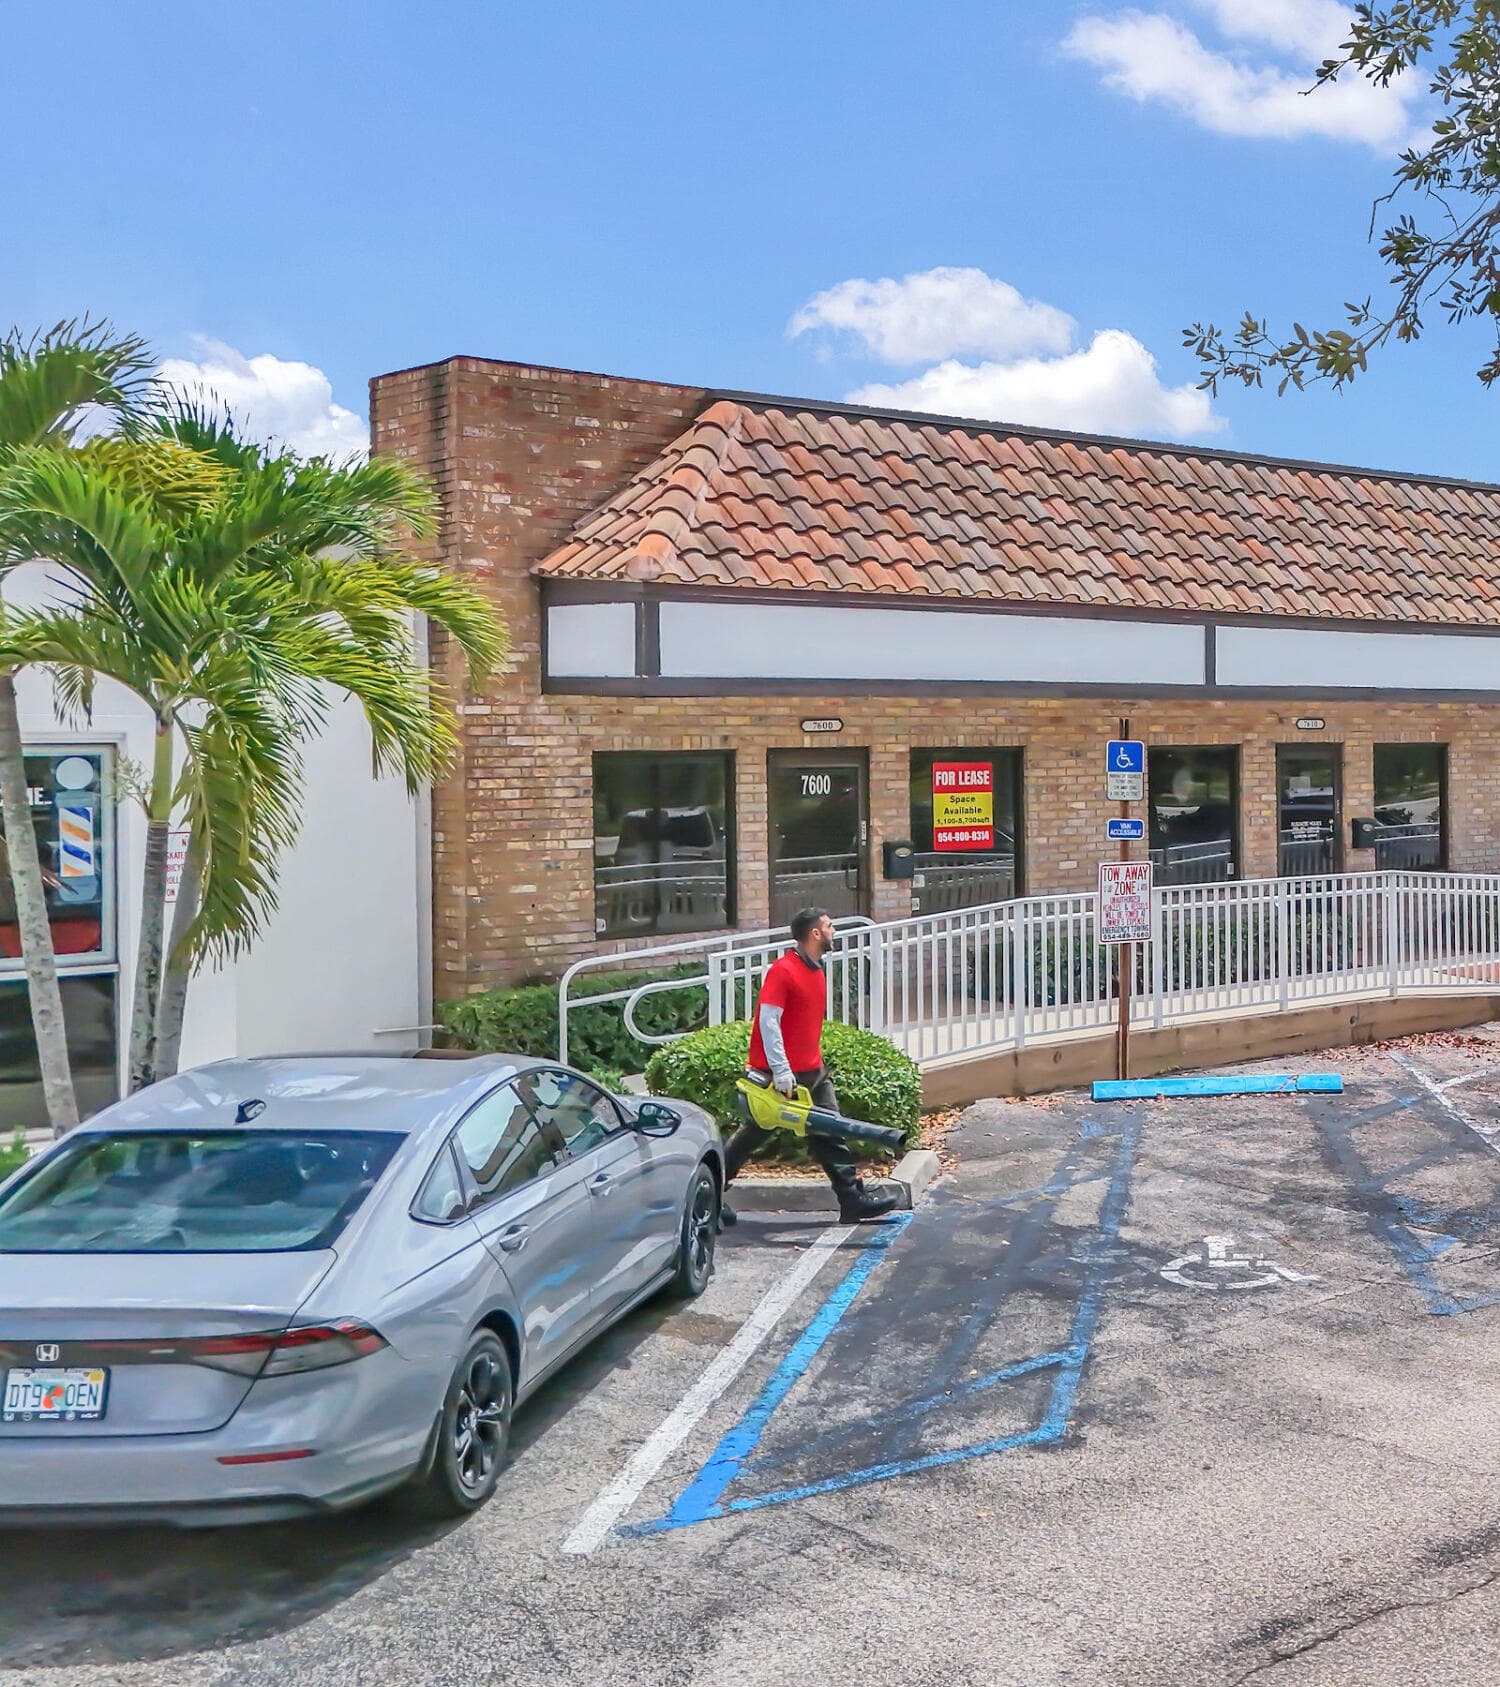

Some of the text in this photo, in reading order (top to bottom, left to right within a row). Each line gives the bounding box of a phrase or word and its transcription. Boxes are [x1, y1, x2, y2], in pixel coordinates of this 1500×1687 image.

[801, 774, 831, 795] 7600
[935, 770, 990, 786] FOR LEASE
[950, 795, 976, 805] Space
[944, 807, 983, 815] Available
[1103, 866, 1148, 881] TOW AWAY
[1114, 881, 1137, 895] ZONE
[8, 1384, 42, 1408] DT9
